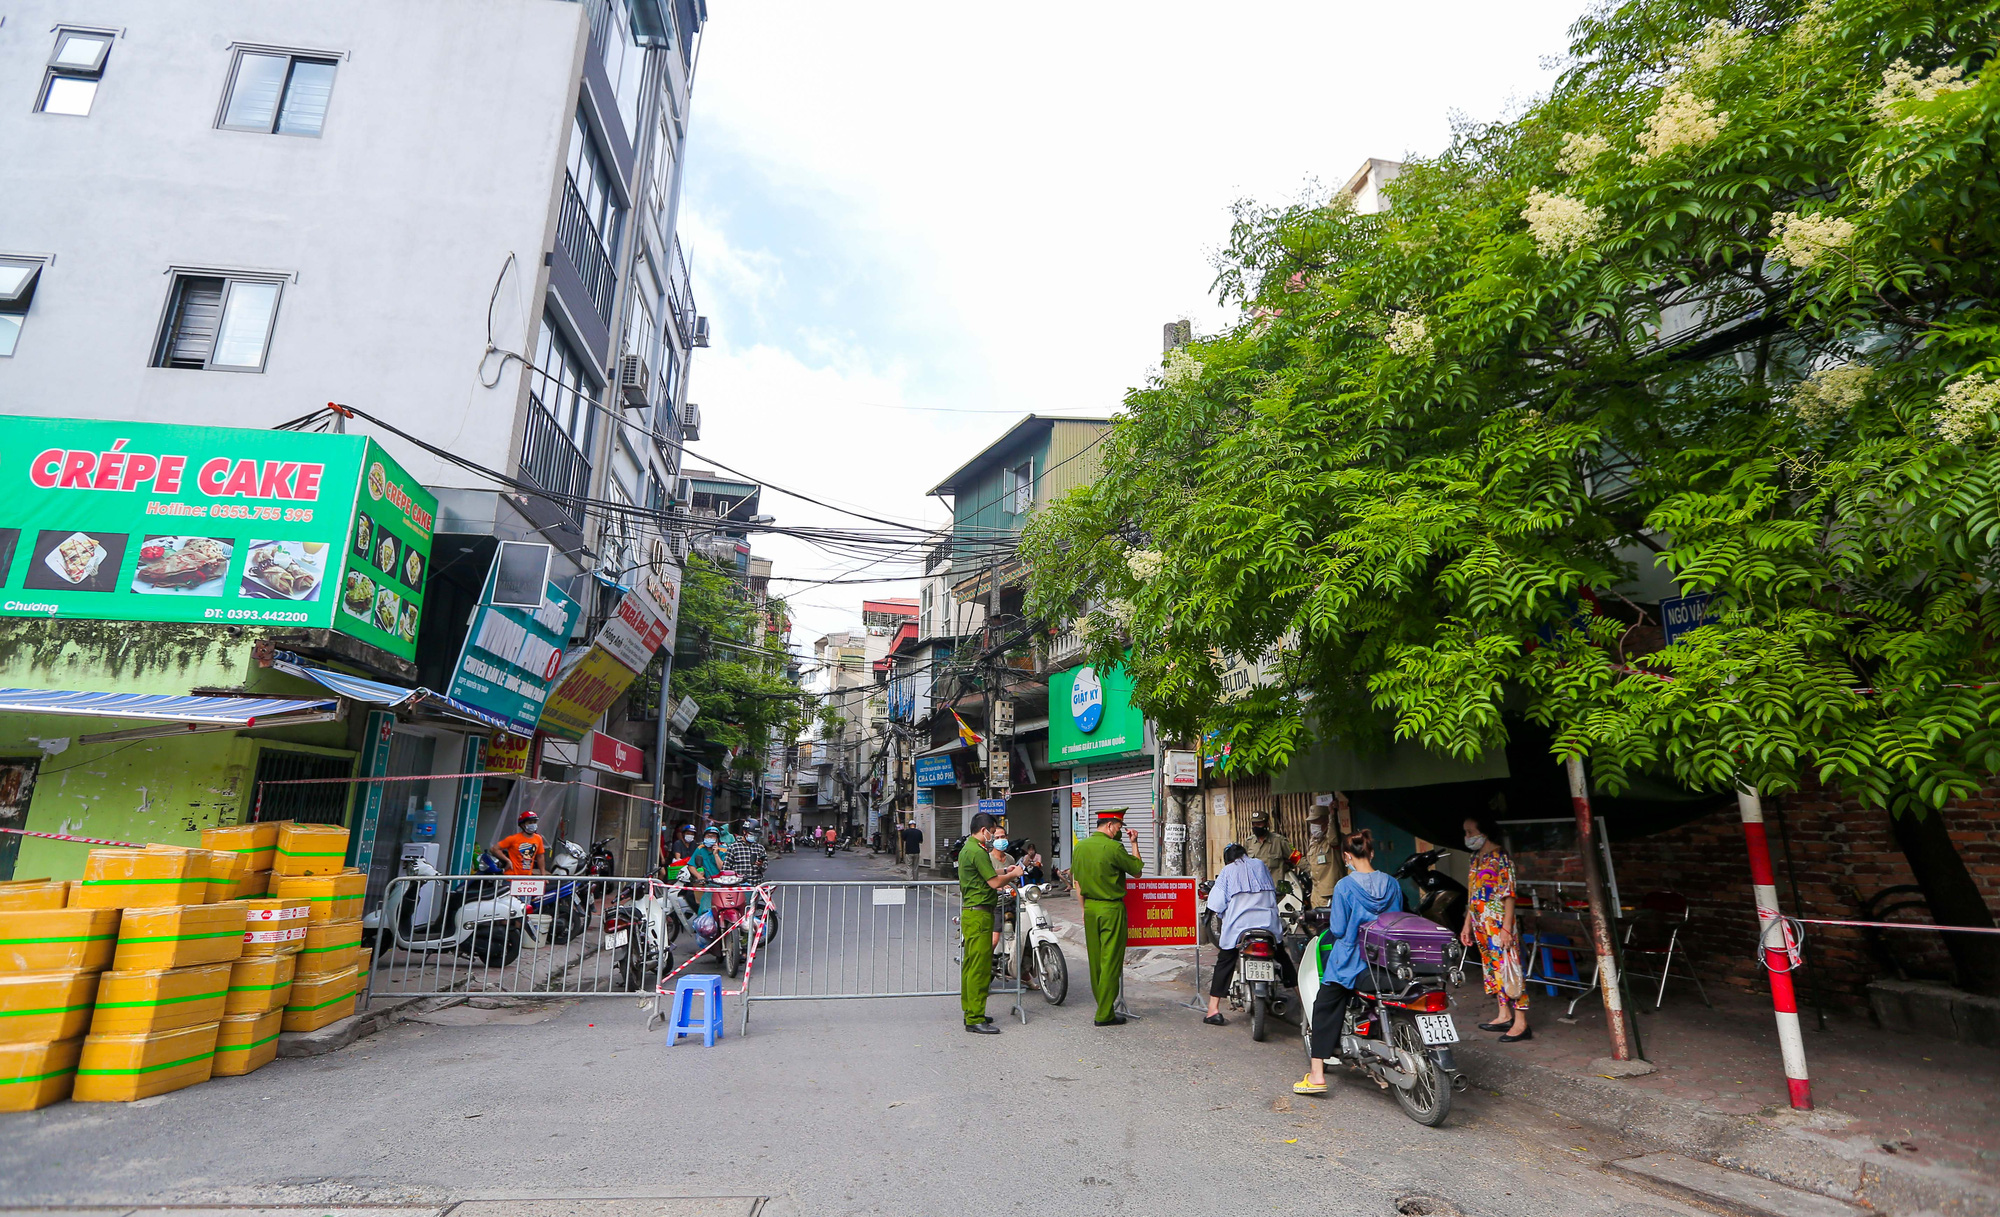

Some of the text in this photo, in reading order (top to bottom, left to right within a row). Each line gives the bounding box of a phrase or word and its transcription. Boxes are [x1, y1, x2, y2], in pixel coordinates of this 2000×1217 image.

[30, 438, 188, 494] CRÉPE
[197, 457, 325, 502] CAKE
[146, 502, 313, 522] Hotline: 0353.755 395
[412, 503, 432, 532] CAKE
[4, 600, 58, 614] Chương
[204, 608, 308, 622] ĐT: 0393.442200
[1668, 603, 1688, 625] NGÕ
[463, 654, 489, 679] CHUYÊN
[484, 664, 500, 684] BÁN
[547, 652, 560, 678] 8
[1074, 690, 1088, 706] GIẶT
[1068, 742, 1082, 754] THỐNG
[1099, 738, 1112, 748] TOÀN
[1112, 734, 1126, 746] QUỐC
[929, 772, 936, 781] CÁ
[1158, 881, 1169, 889] CHỐNG
[1147, 905, 1173, 919] ĐIỂM CHỐT
[1128, 924, 1195, 940] HÒNG CHỐNG DỊCH COVID-19
[1250, 971, 1270, 979] 7861
[1426, 1029, 1454, 1042] 3448
